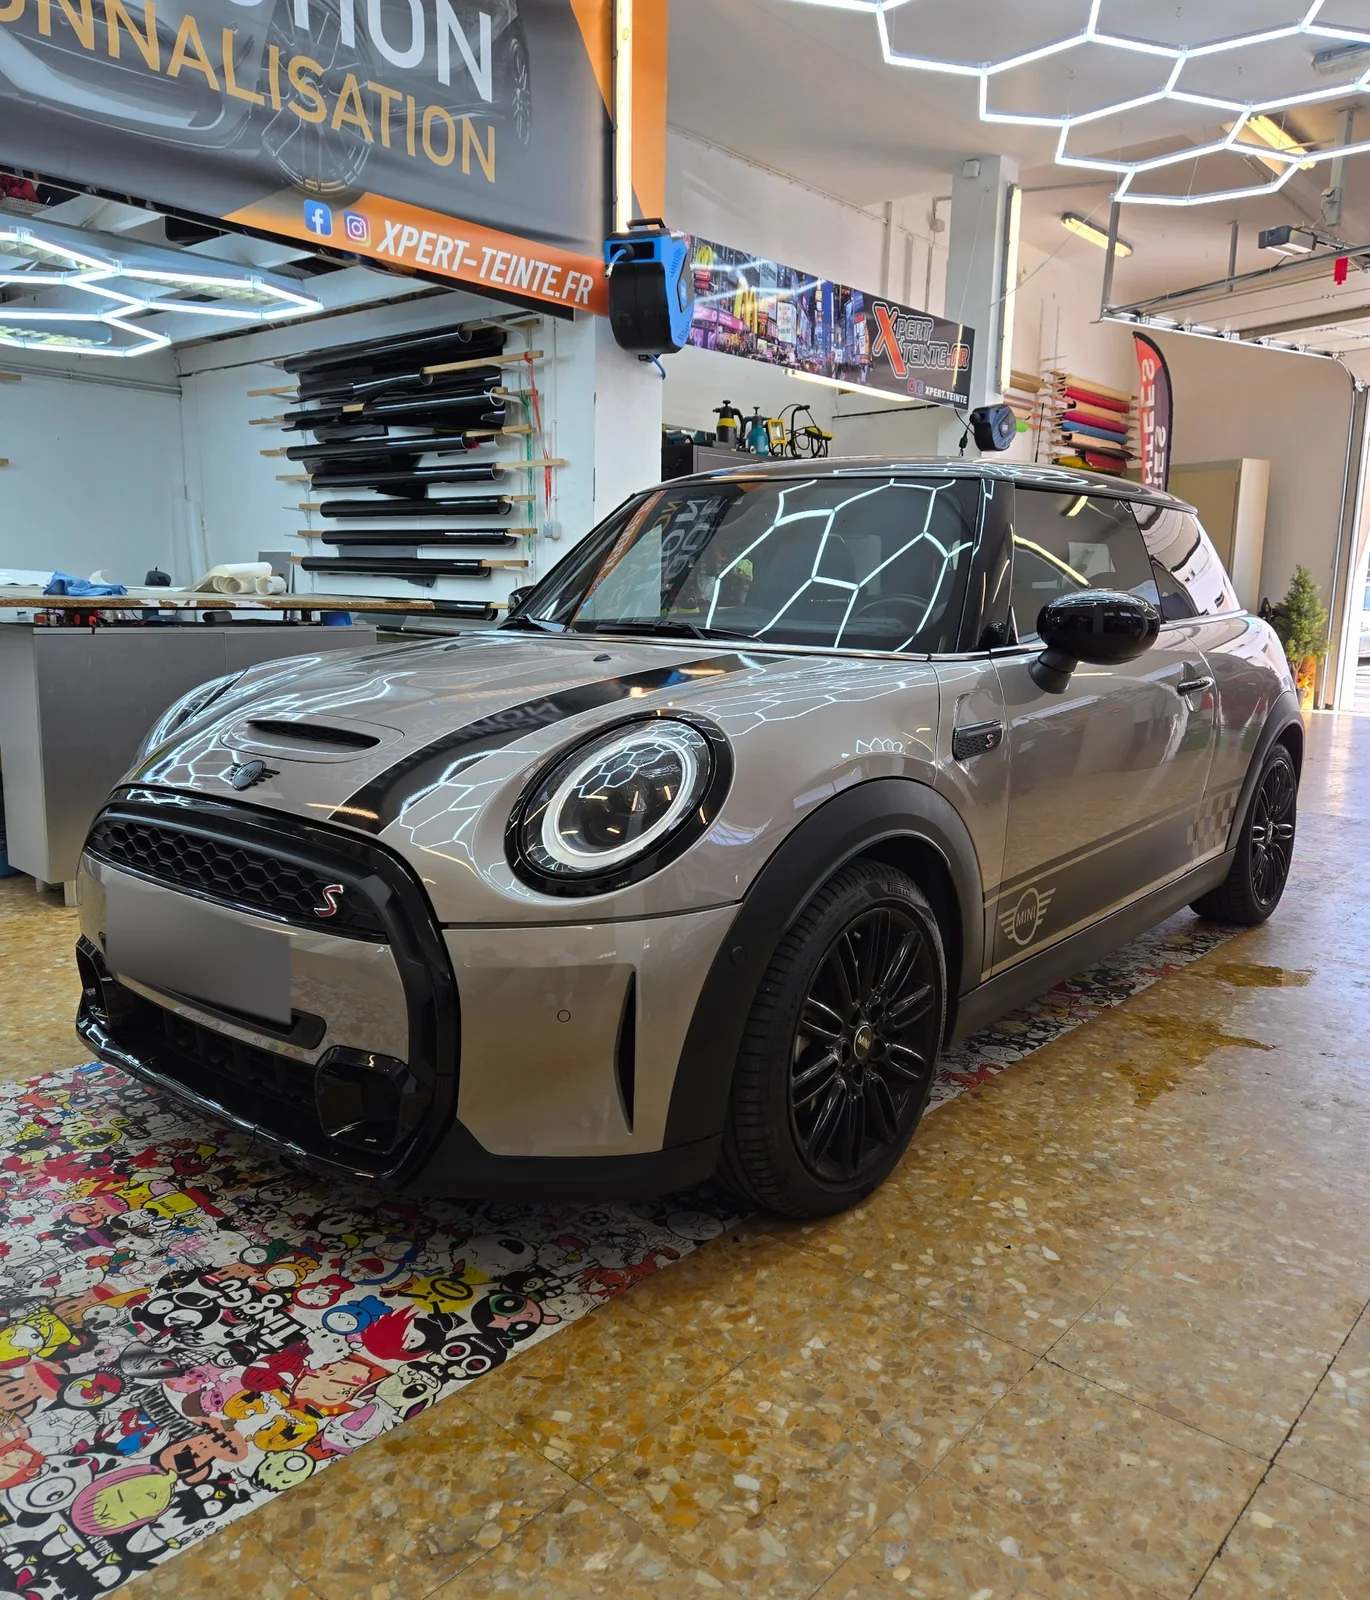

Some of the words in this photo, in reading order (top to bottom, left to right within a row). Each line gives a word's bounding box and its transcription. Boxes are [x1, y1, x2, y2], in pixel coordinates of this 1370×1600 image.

[376, 219, 594, 305] XPERT-TEINTE.FR
[924, 385, 968, 405] XPERT.TEINTE
[313, 884, 344, 918] S
[1015, 905, 1037, 928] MINI
